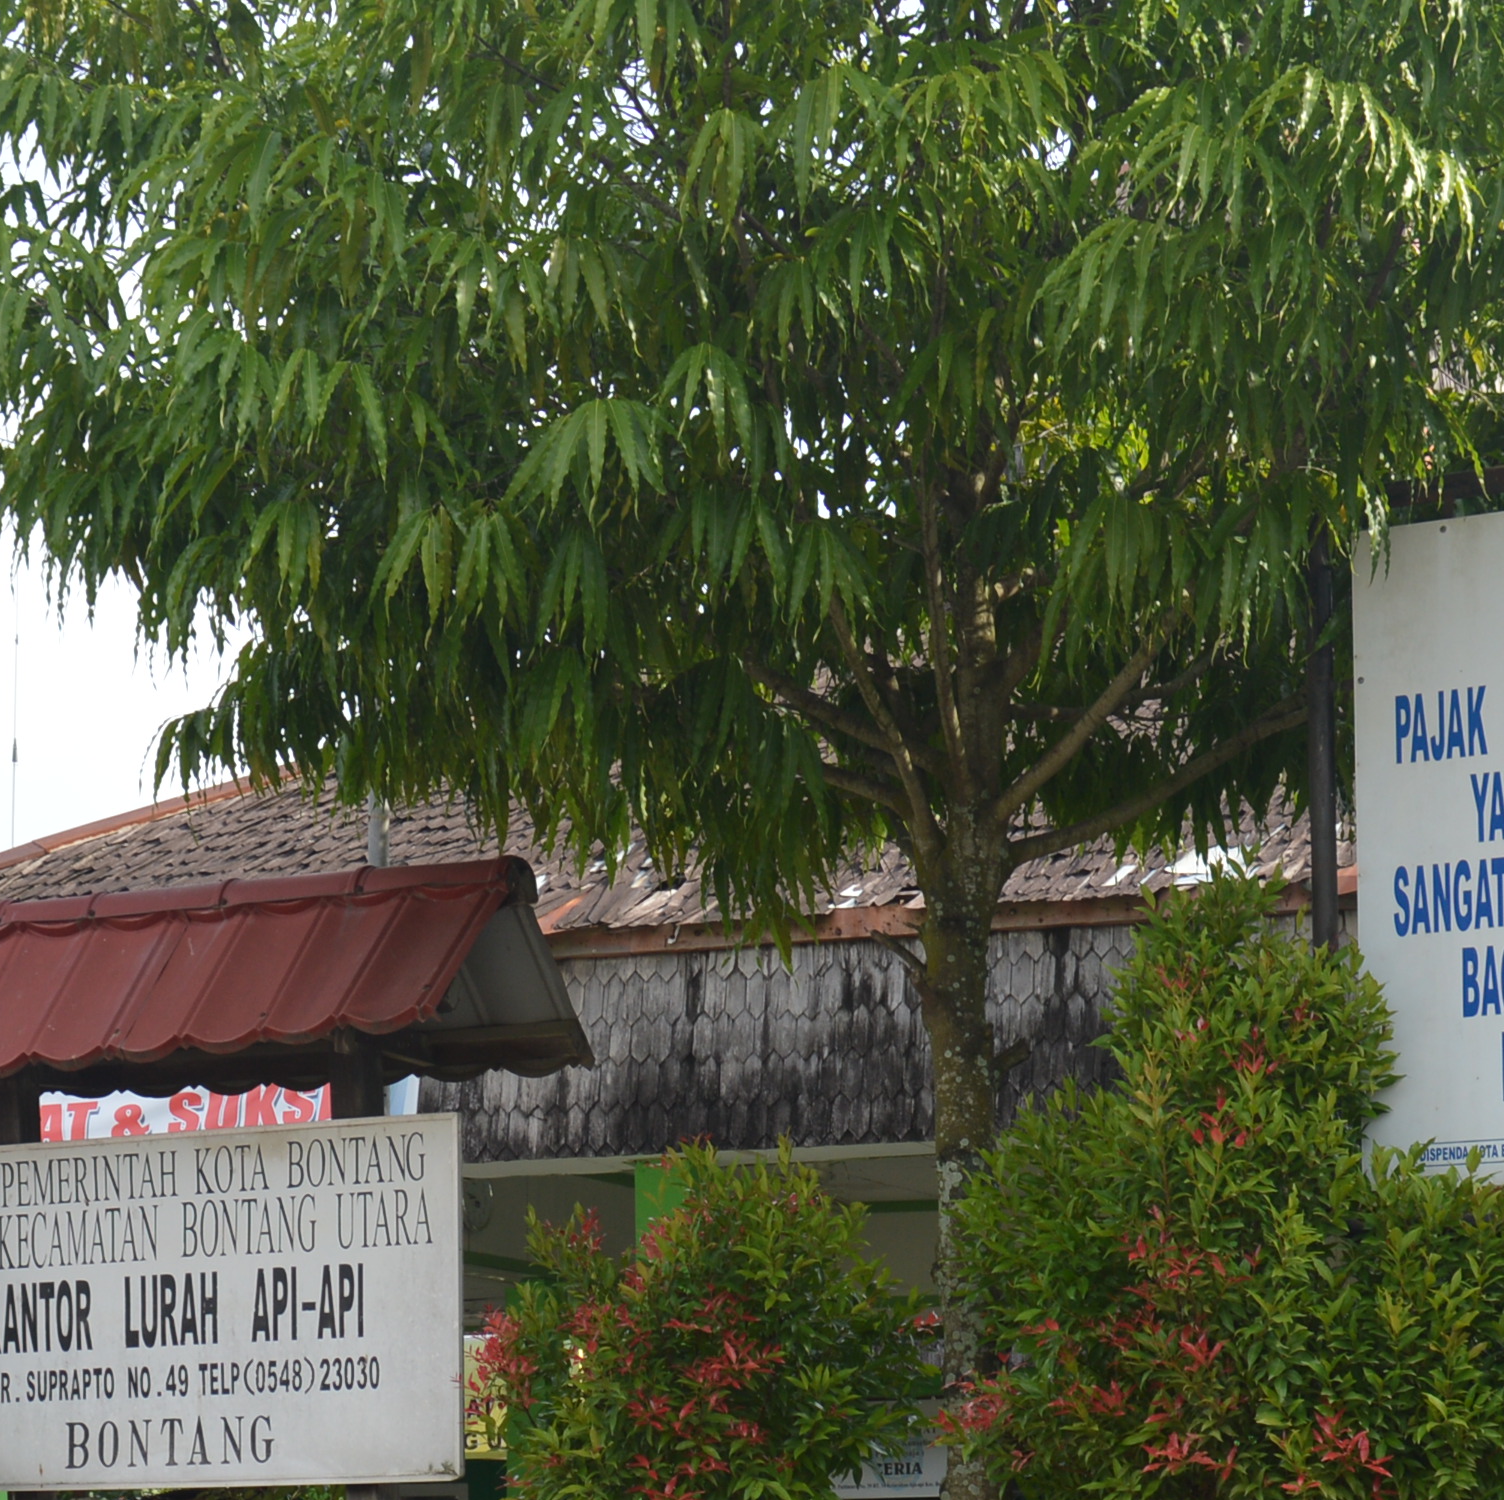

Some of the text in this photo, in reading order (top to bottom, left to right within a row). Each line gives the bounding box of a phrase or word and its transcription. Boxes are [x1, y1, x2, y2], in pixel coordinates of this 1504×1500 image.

[1394, 685, 1488, 765] PAJAK
[111, 1104, 149, 1137] &
[0, 1131, 426, 1208] PEMERINTAH KOTA BONTANG
[181, 1193, 317, 1258] BONTANG
[335, 1187, 434, 1250] UTARA
[124, 1271, 219, 1349] LURAH
[251, 1262, 364, 1343] API-API
[64, 1415, 275, 1470] BONTANG
